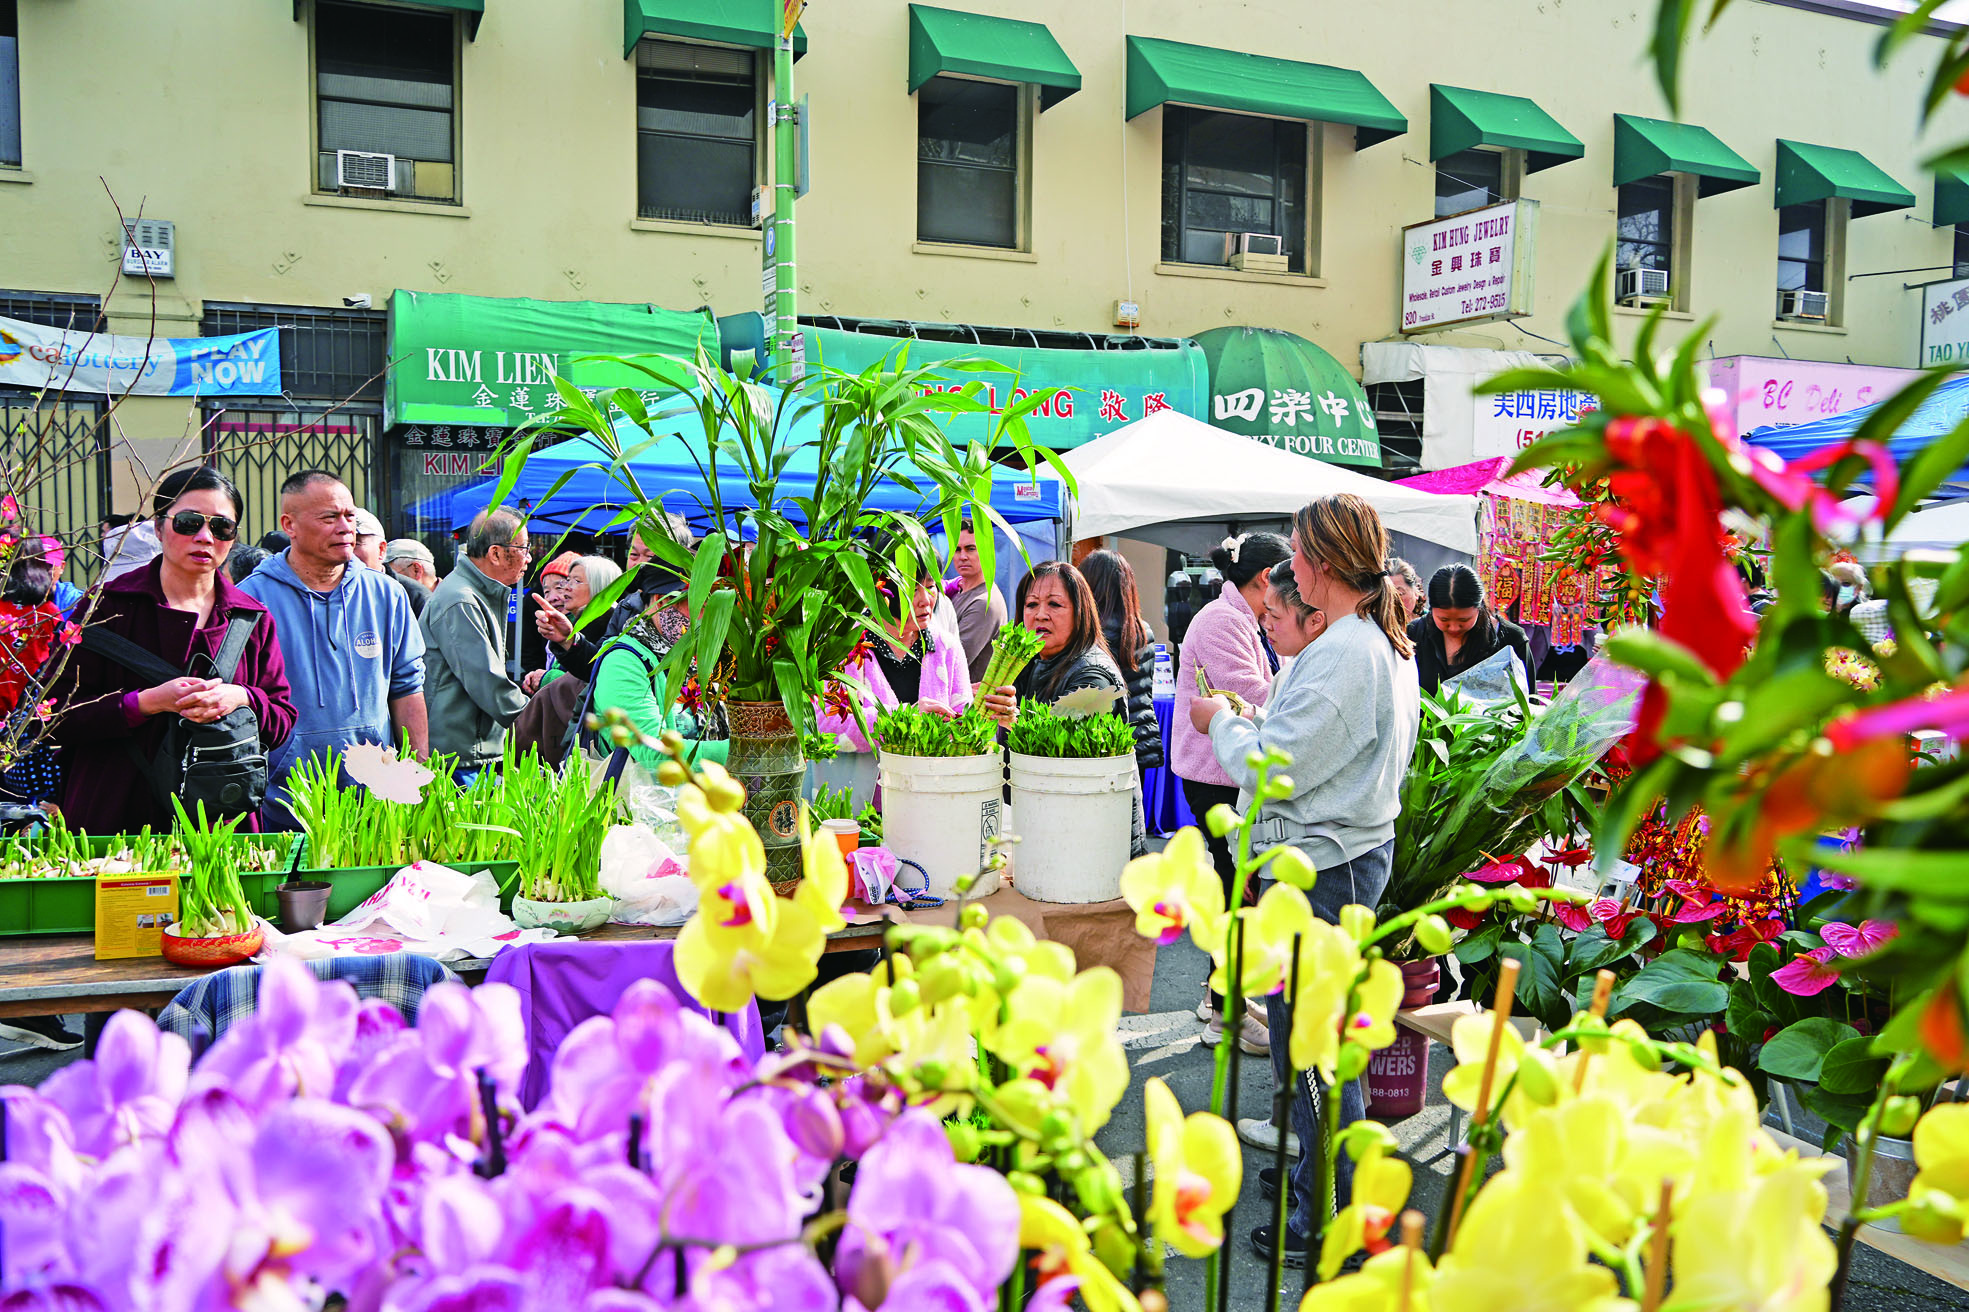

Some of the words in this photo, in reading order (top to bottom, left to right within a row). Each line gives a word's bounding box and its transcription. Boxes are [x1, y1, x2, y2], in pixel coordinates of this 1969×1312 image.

[1432, 230, 1447, 252] KIM
[1449, 225, 1470, 248] HUNG
[1473, 215, 1510, 242] JEWELRY
[131, 249, 164, 260] BAY
[191, 338, 266, 362] PLAY
[1929, 343, 1953, 363] TAO
[191, 361, 266, 385] NOW
[426, 347, 482, 383] KIM
[495, 351, 559, 385] LIEN
[1763, 379, 1793, 411] BC
[1284, 435, 1335, 455] FOUR
[423, 453, 470, 475] KIM
[1495, 576, 1514, 600] 福
[1370, 1087, 1410, 1098] 88-0813
